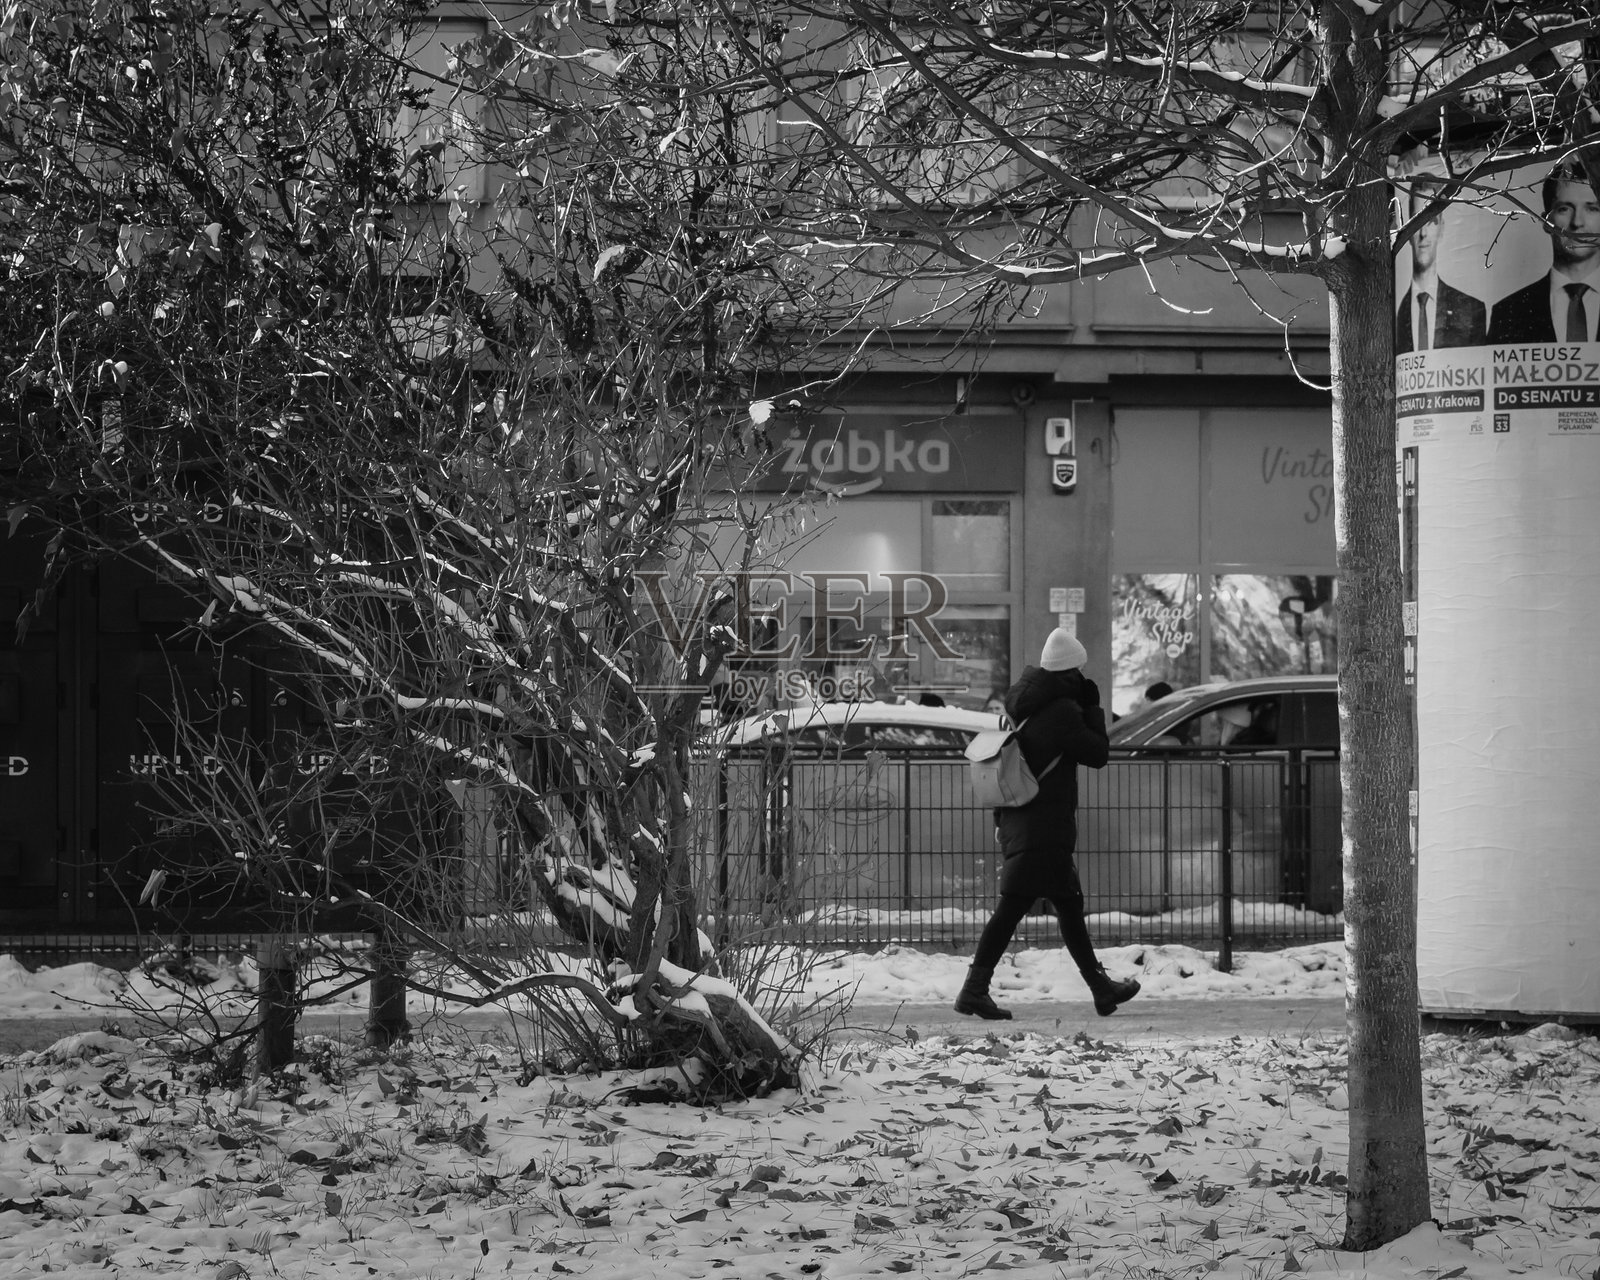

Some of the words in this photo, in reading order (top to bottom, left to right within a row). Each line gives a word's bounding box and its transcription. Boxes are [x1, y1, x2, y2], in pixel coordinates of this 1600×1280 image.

[1493, 347, 1581, 363] MATEUSZ
[1494, 363, 1600, 384] MAŁODZ
[1401, 397, 1425, 412] SENATU
[1427, 398, 1432, 409] z
[1434, 394, 1480, 409] Krakowa
[1498, 391, 1517, 404] Do
[1521, 389, 1582, 404] SENATU
[1586, 391, 1595, 402] z
[1496, 420, 1508, 431] 33
[781, 428, 950, 473] żabka
[1262, 446, 1334, 484] Vinta
[1123, 598, 1196, 632] Vintage
[1151, 622, 1194, 653] Shop
